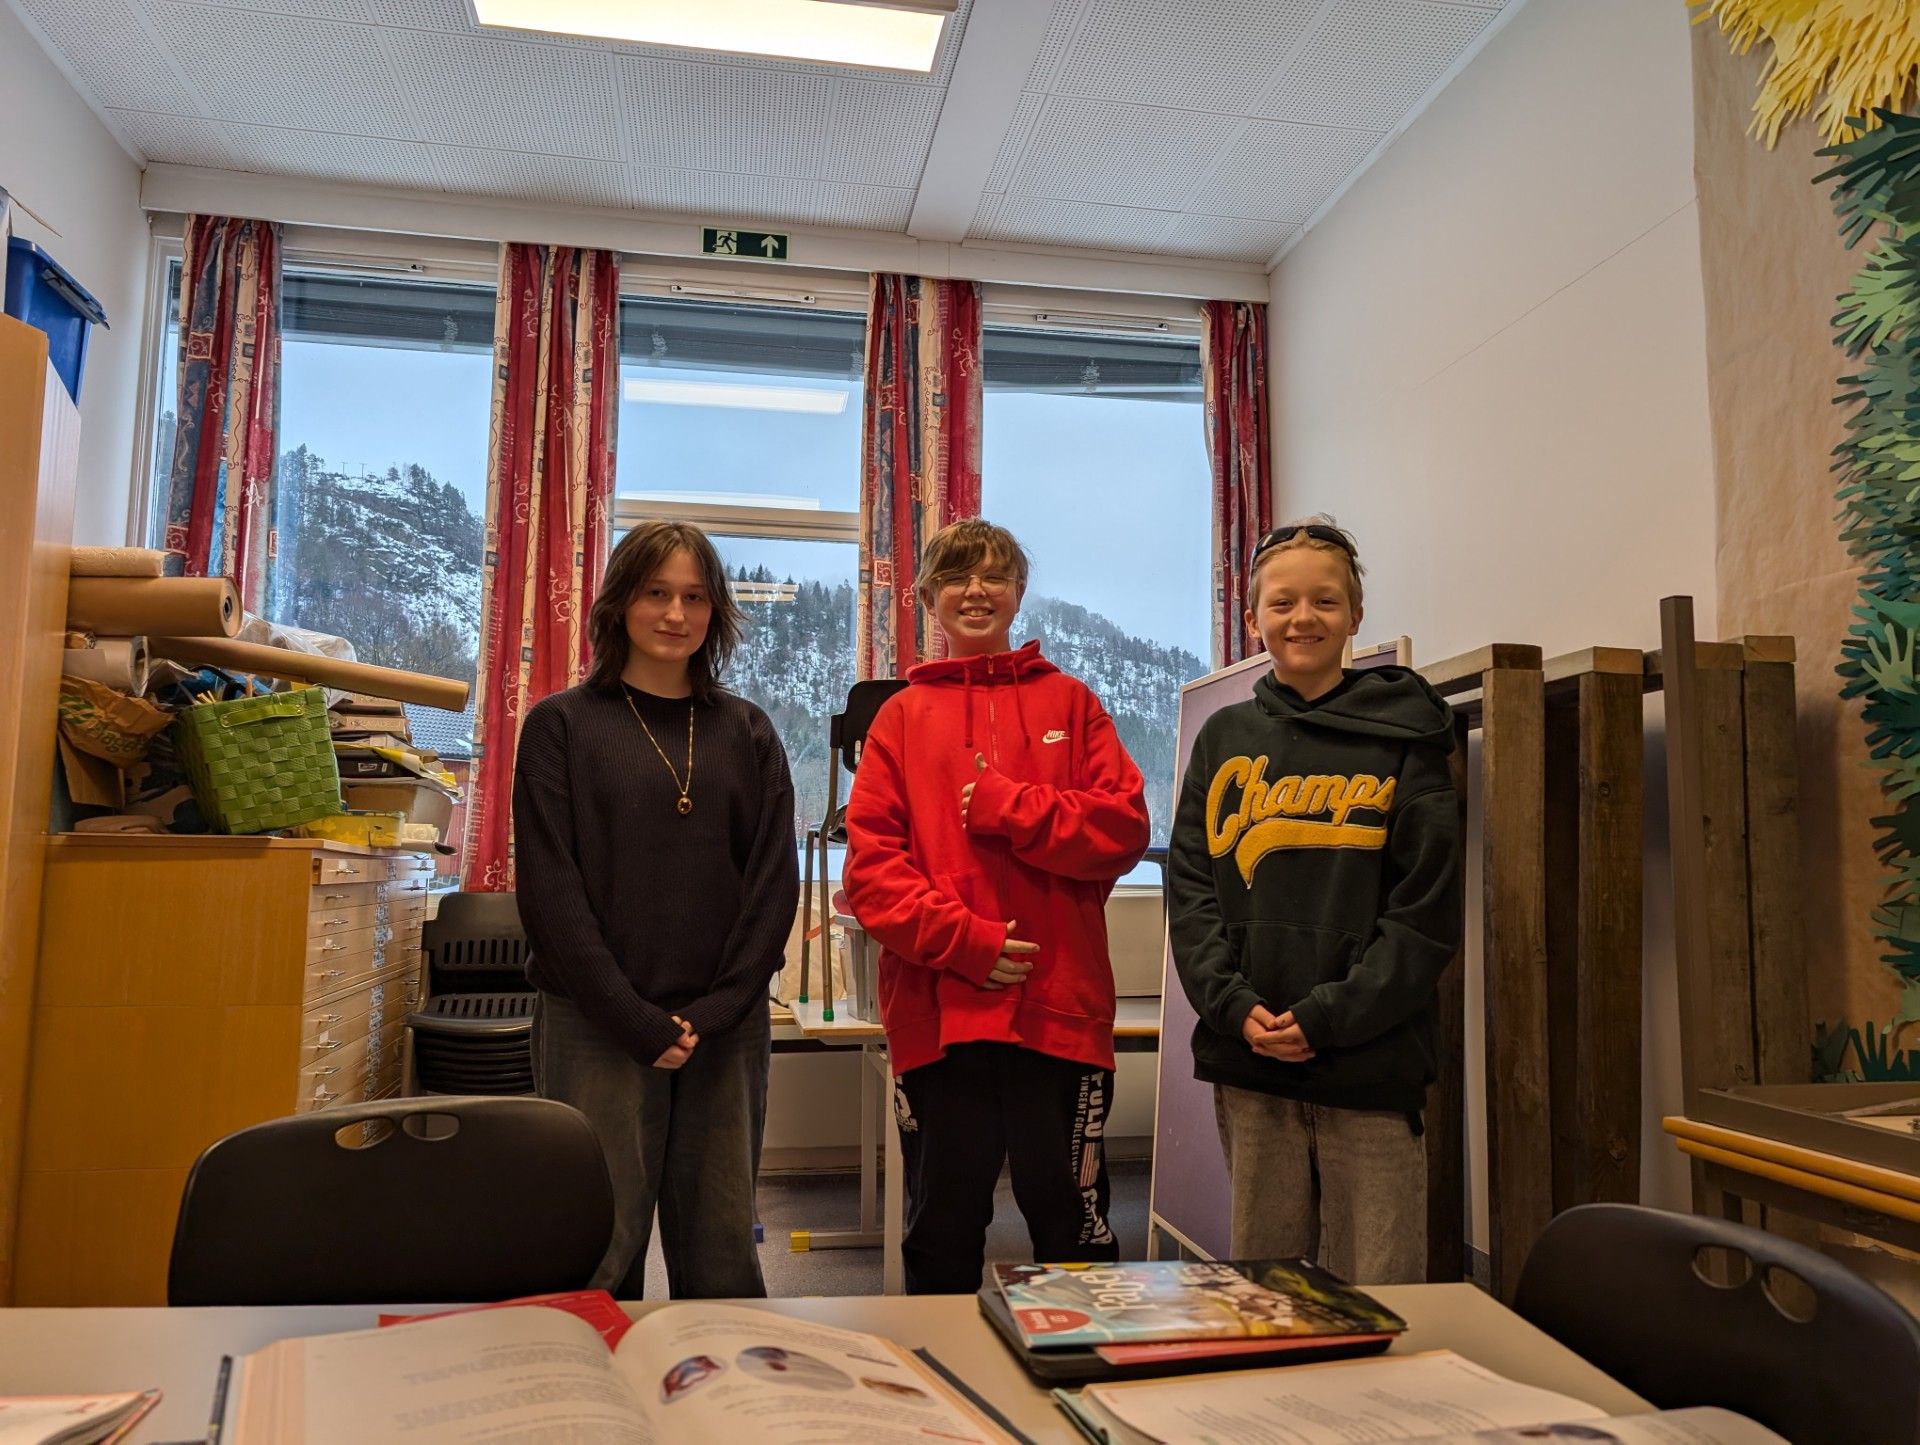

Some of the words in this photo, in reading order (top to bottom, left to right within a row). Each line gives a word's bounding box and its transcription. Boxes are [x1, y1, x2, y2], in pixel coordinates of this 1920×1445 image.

[1046, 729, 1066, 739] NIKE
[1205, 754, 1397, 858] Champs
[1076, 1074, 1090, 1115] VINCENT
